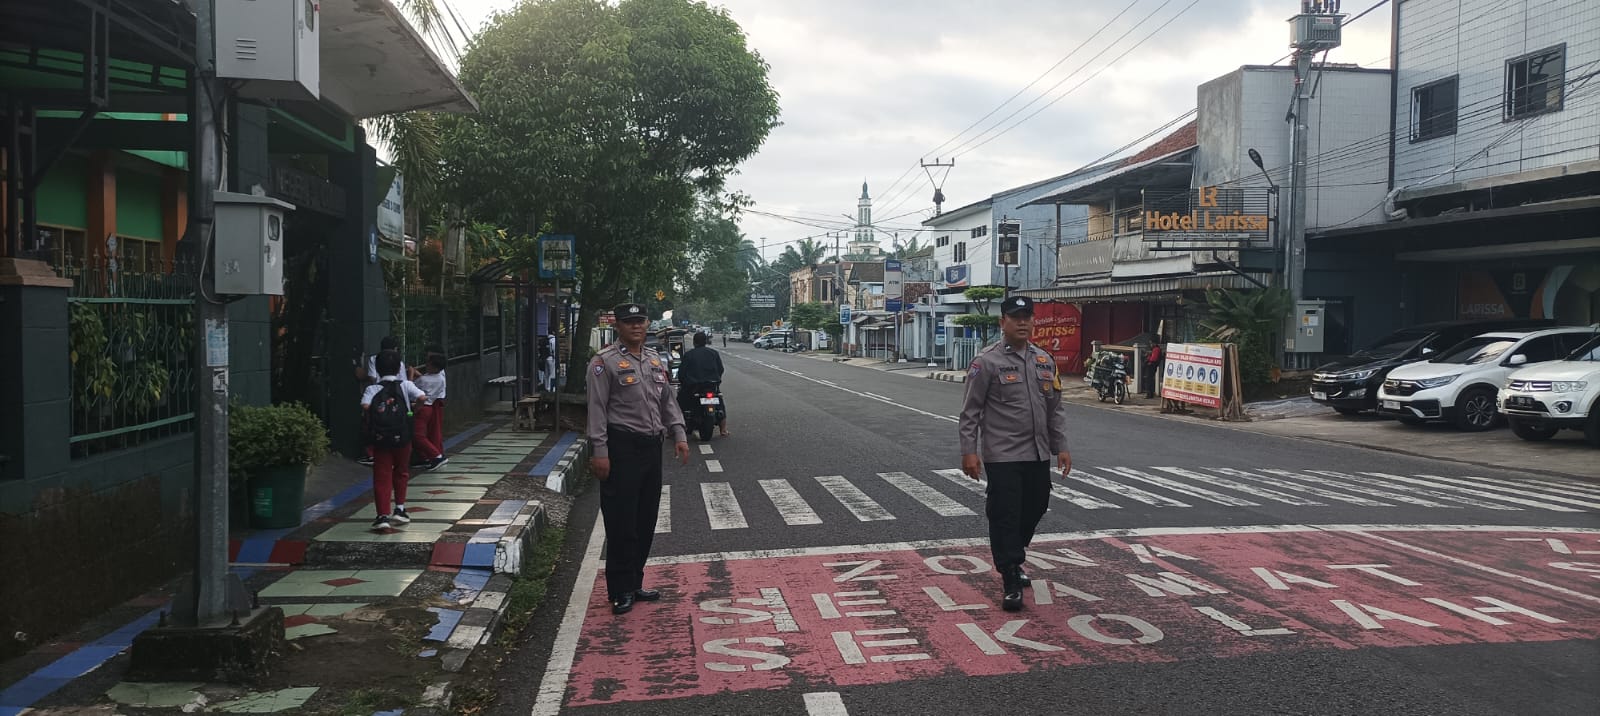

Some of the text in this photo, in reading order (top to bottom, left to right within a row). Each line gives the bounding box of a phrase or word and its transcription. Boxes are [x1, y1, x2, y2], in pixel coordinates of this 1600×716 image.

[1146, 209, 1268, 231] Hotel Larissa
[1460, 303, 1504, 314] LARISSA
[1032, 326, 1076, 339] Larissa
[1051, 338, 1061, 351] 2
[821, 543, 1198, 584] ZONA
[699, 564, 1422, 627] SELAMAT
[702, 595, 1566, 673] SEKOLAH
